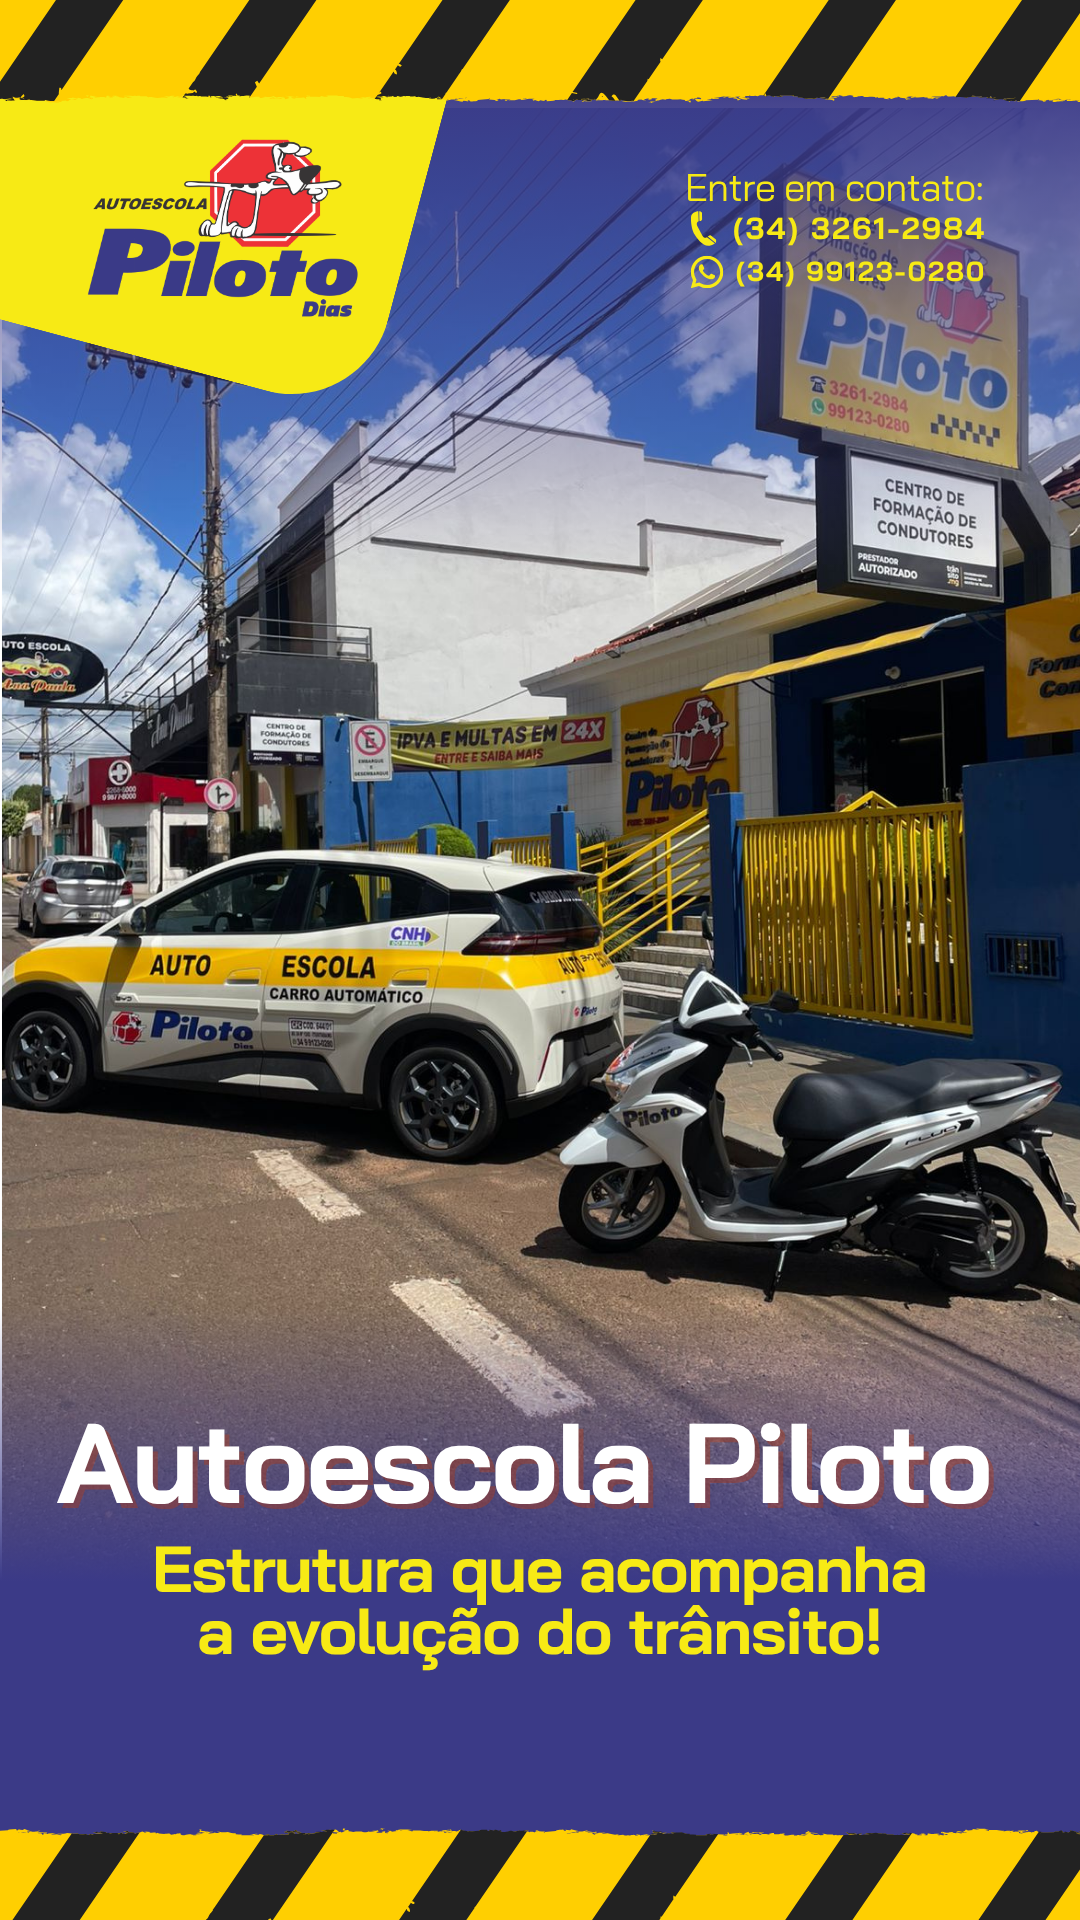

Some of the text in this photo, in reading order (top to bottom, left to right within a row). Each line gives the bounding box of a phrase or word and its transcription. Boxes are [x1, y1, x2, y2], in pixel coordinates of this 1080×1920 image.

[799, 285, 1009, 410] Piloto
[829, 380, 909, 413] 3261-2984
[827, 403, 910, 433] 99123-0280
[885, 478, 965, 506] CENTRO DE
[873, 497, 977, 529] FORMAÇÃO DE
[877, 520, 974, 549] CONDUTORES
[857, 552, 899, 565] PRESTADOR
[858, 562, 918, 579] AUTORIZADO
[28, 642, 71, 652] ESCOLA
[31, 679, 77, 693] Paula
[260, 731, 301, 739] FORMAÇÃO
[262, 738, 310, 747] CONDUTORES
[397, 719, 604, 750] IPVA E MULTAS EM 24X
[434, 748, 544, 764] ENTRE E SAIBA MAIS
[391, 926, 426, 941] CNH
[150, 954, 376, 979] AUTO ESCOLA
[558, 956, 585, 975] AUTO
[269, 987, 423, 1003] CARRO AUTOMÁTICO
[150, 1009, 253, 1041] Piloto
[233, 1042, 254, 1050] Dias
[623, 1106, 683, 1128] Piloto
